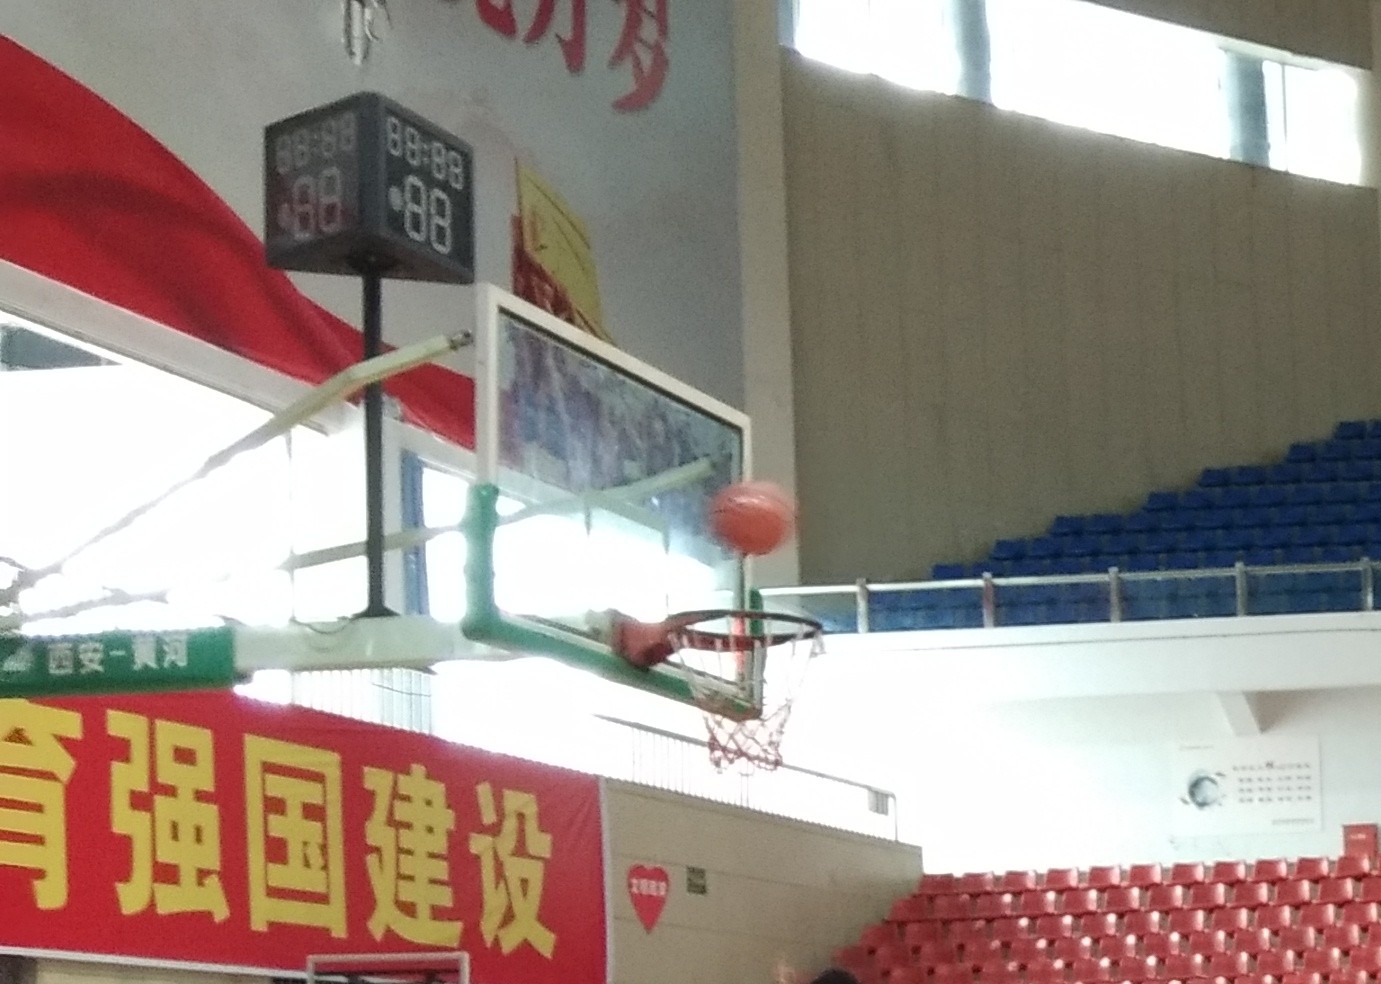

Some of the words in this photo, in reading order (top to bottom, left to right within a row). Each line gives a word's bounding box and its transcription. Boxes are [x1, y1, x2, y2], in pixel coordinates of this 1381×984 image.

[0, 698, 557, 960] 育强国建设
